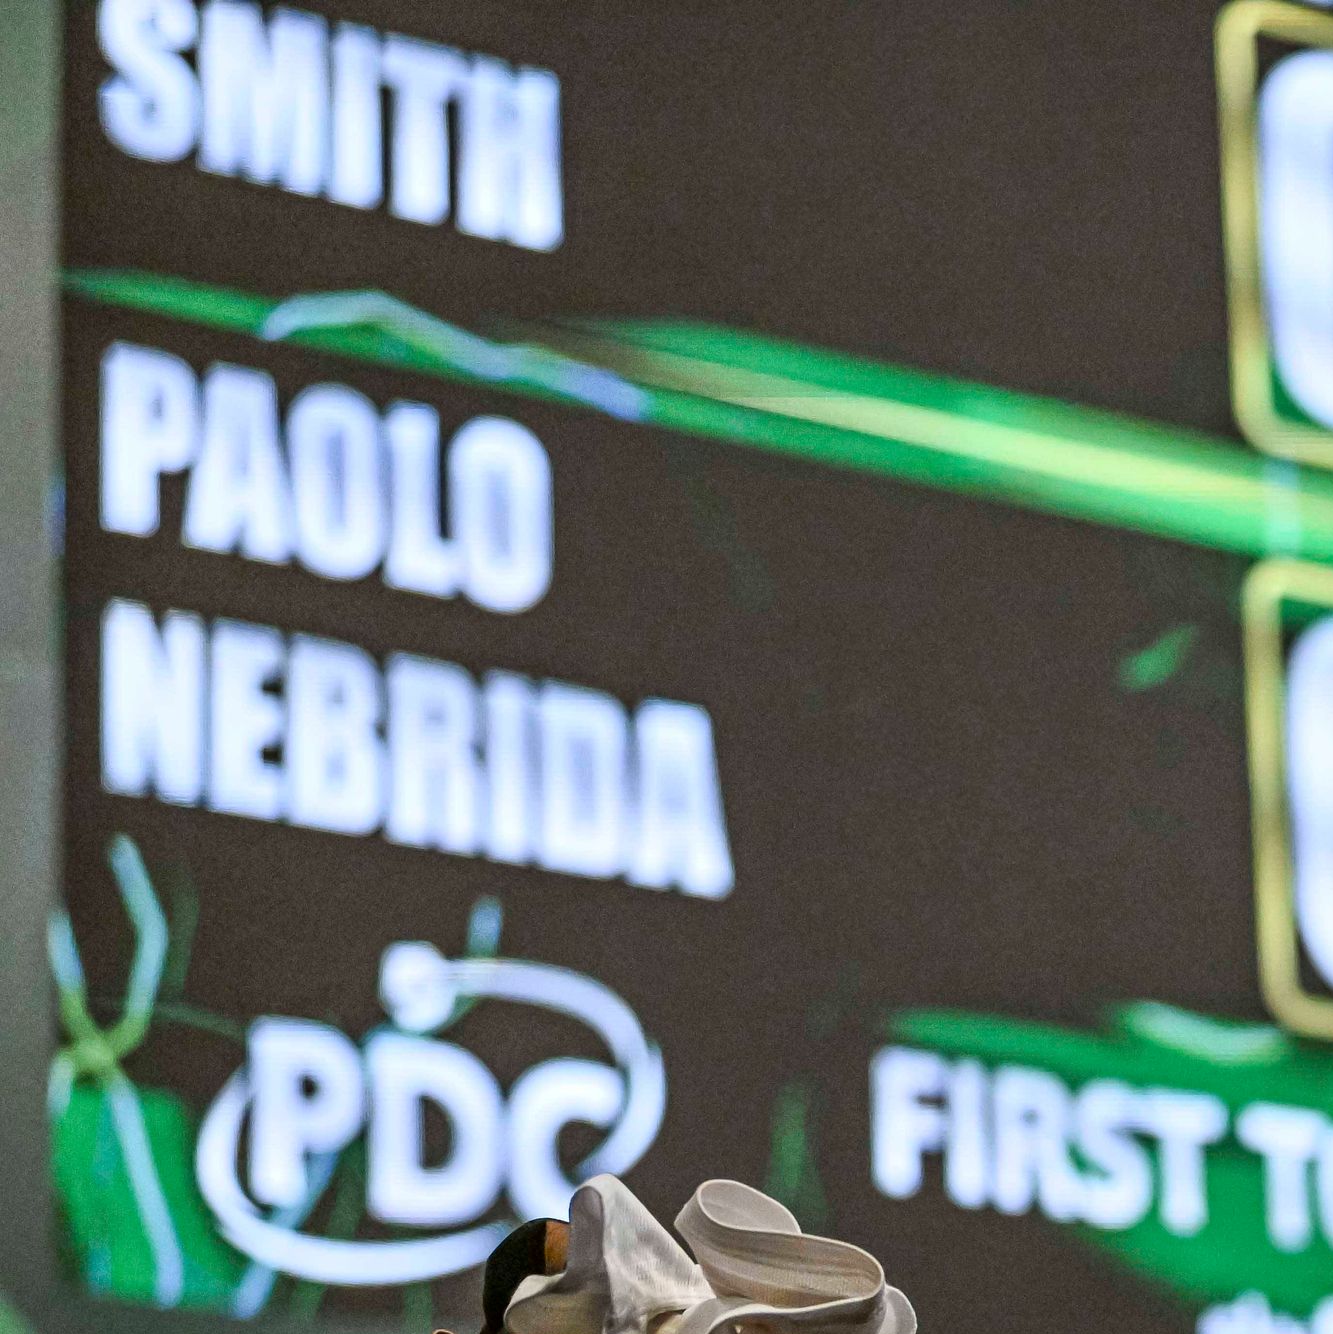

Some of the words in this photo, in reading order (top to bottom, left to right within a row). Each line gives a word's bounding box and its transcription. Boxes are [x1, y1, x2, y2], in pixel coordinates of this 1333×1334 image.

[97, 0, 565, 252] SMITH
[99, 341, 555, 614] PAOLO
[100, 597, 735, 901] NEBRIDA
[245, 1013, 628, 1226] PDC
[868, 1045, 1228, 1237] FIRST
